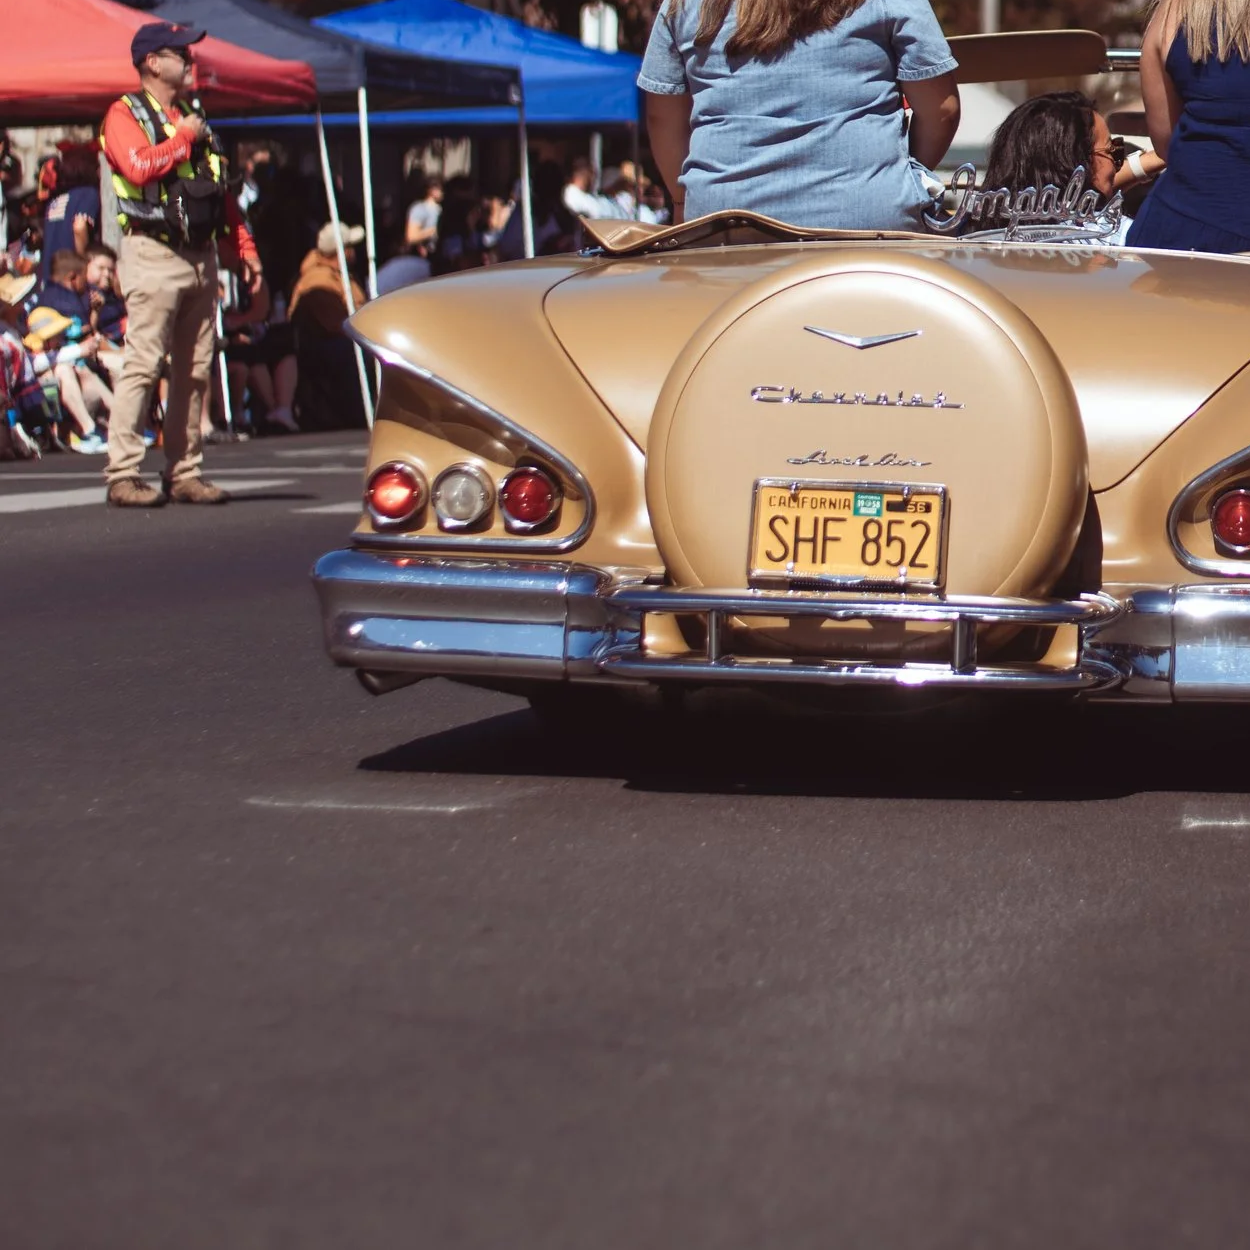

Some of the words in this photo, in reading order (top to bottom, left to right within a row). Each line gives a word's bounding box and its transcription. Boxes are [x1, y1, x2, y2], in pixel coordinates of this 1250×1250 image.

[750, 386, 966, 409] Chevrolet
[769, 495, 851, 511] CALIFORNIA
[906, 501, 926, 513] 56
[765, 514, 848, 565] SHF
[860, 517, 932, 569] 852
